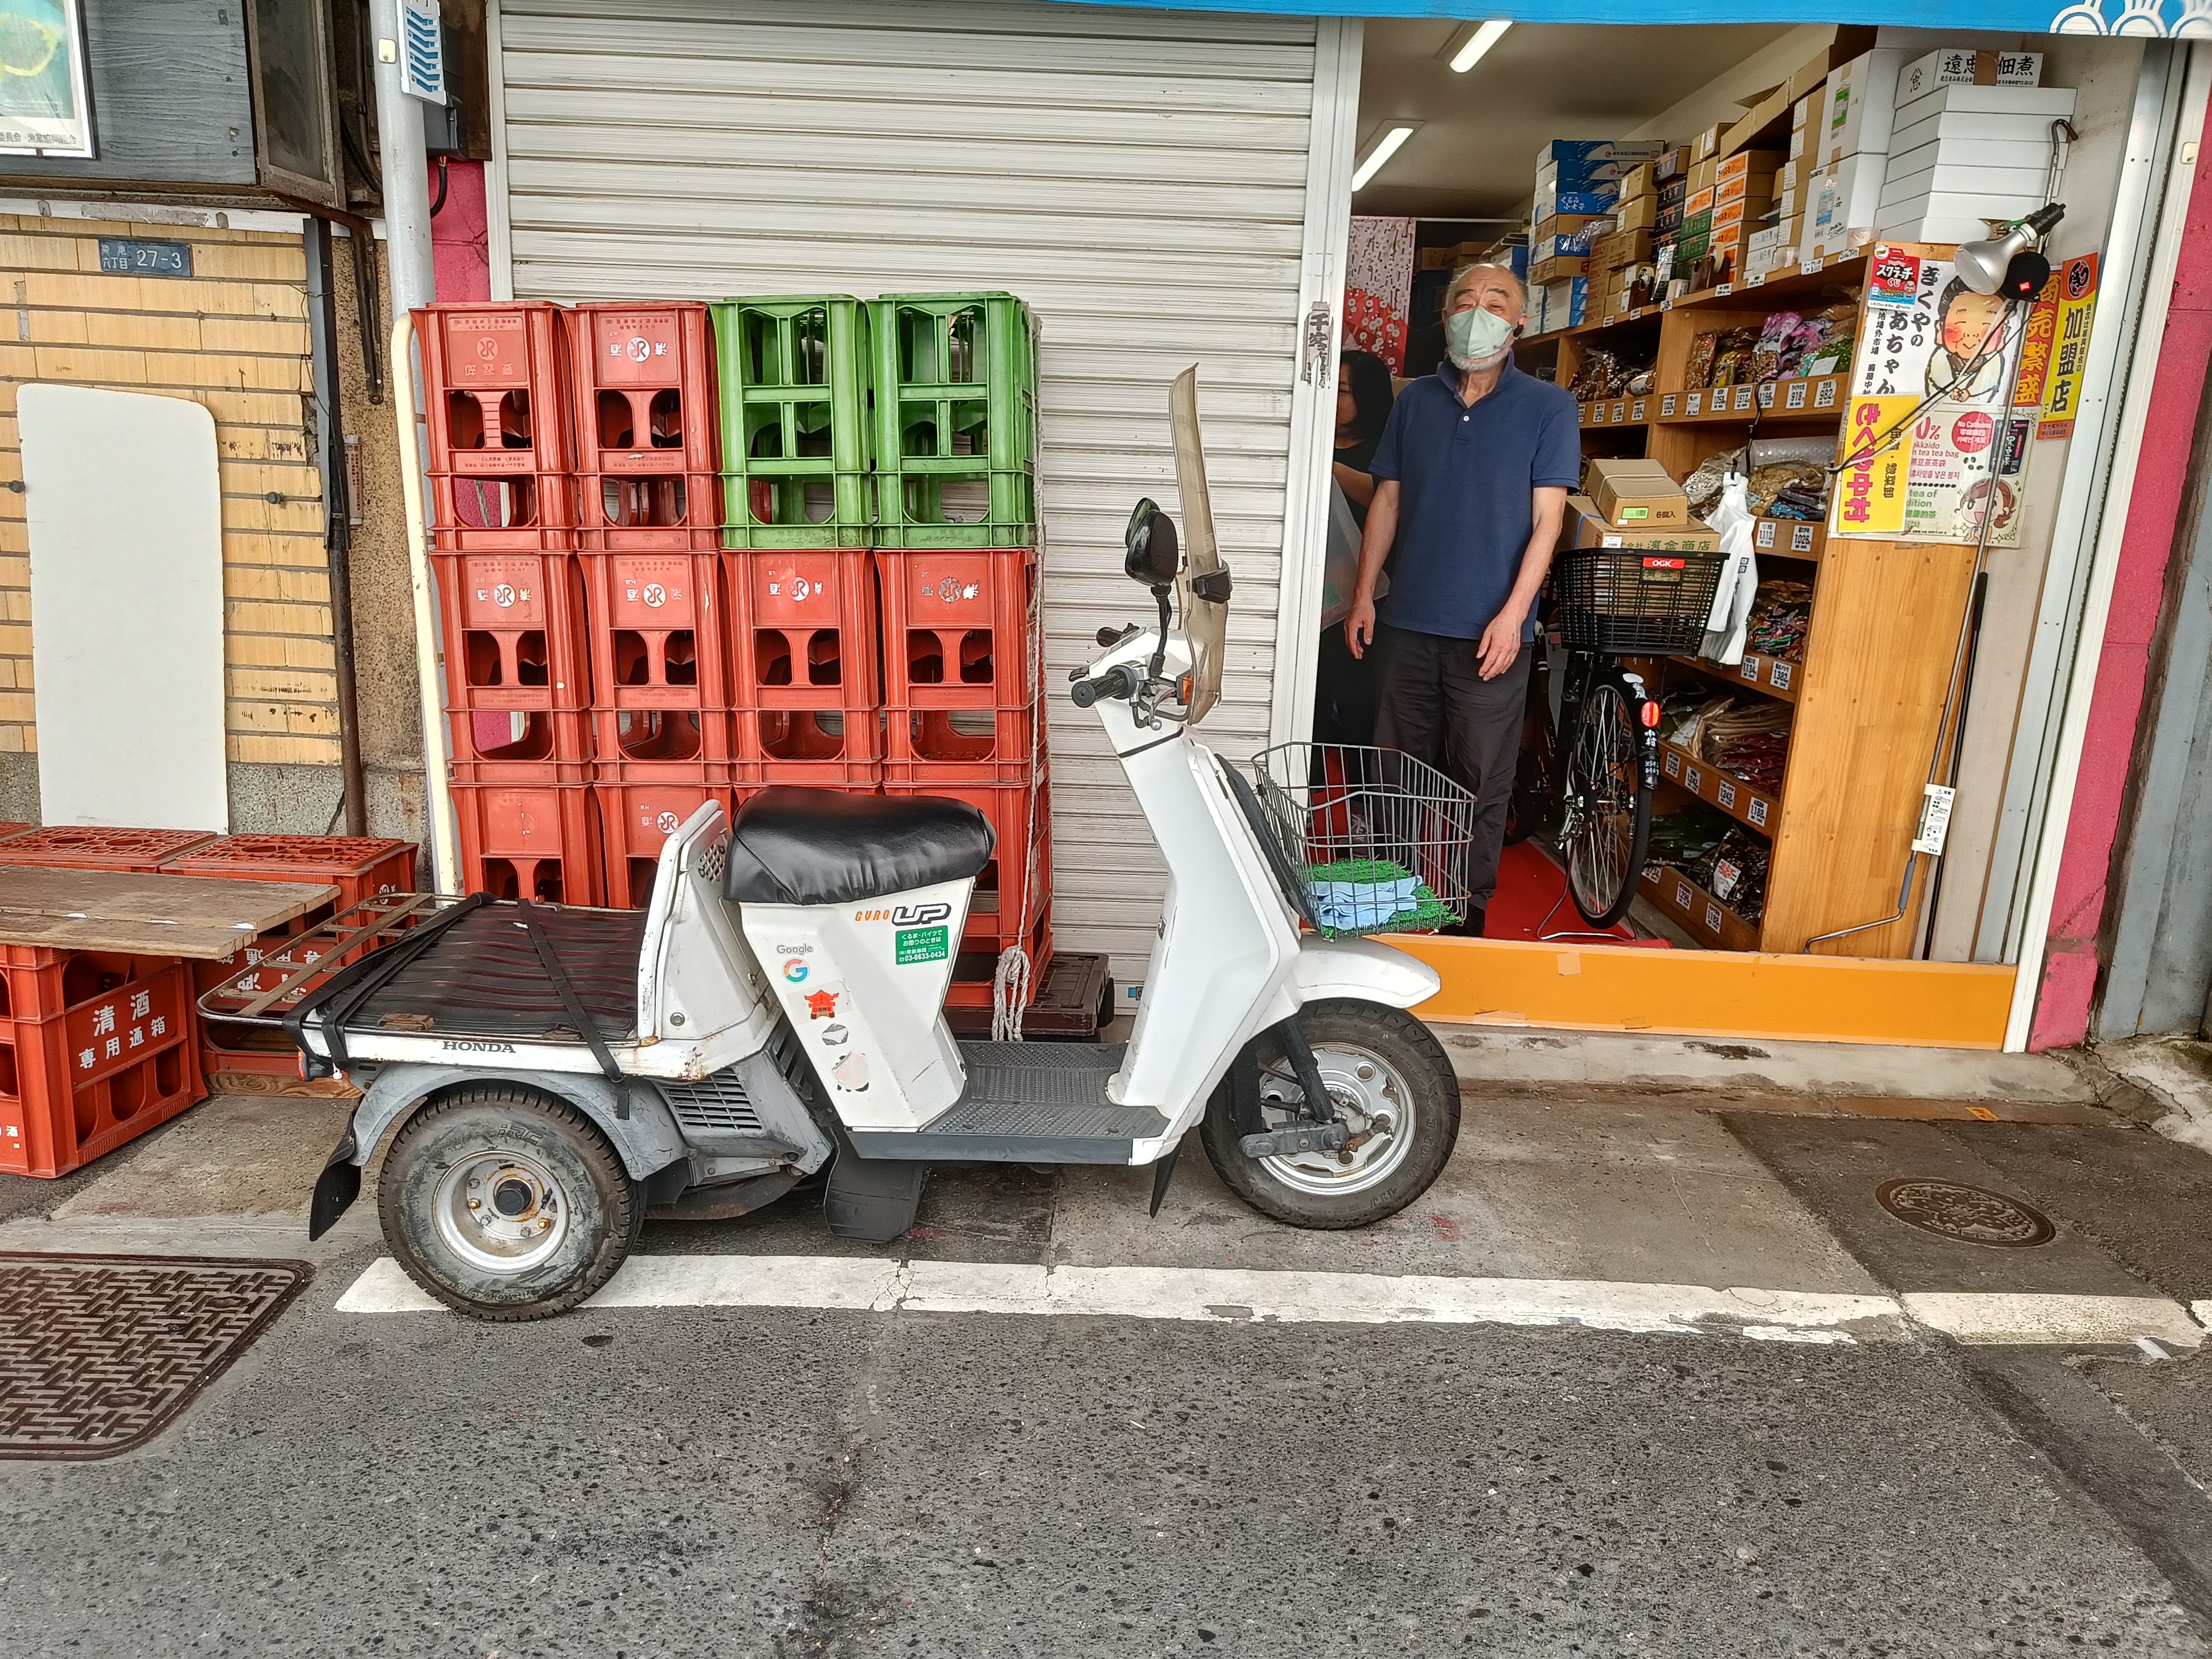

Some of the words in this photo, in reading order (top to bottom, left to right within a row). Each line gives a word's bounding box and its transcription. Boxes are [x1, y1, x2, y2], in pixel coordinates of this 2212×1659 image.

[1998, 56, 2035, 76] 佃煮
[102, 257, 128, 269] 六丁目
[136, 249, 183, 269] 27-3
[1876, 264, 1913, 280] スクラッチ
[1887, 277, 1901, 287] くじ
[610, 343, 622, 356] 酒
[655, 342, 667, 356] 清
[2051, 307, 2083, 413] 加盟店
[1945, 449, 1959, 459] bag
[1927, 489, 1938, 498] of
[477, 589, 489, 601] 酒
[519, 588, 532, 601] 清
[626, 588, 640, 602] 酒
[769, 583, 782, 595] 酒
[1644, 729, 1657, 747] 中村
[855, 909, 890, 921] GYRO
[892, 902, 952, 927] UP
[902, 936, 942, 947] お困りのときは
[777, 944, 813, 955] Google
[905, 950, 945, 962] 03-6633-0434
[78, 1015, 166, 1069] 専用通箱
[442, 1040, 517, 1054] HONDA
[6, 1125, 18, 1137] 酒
